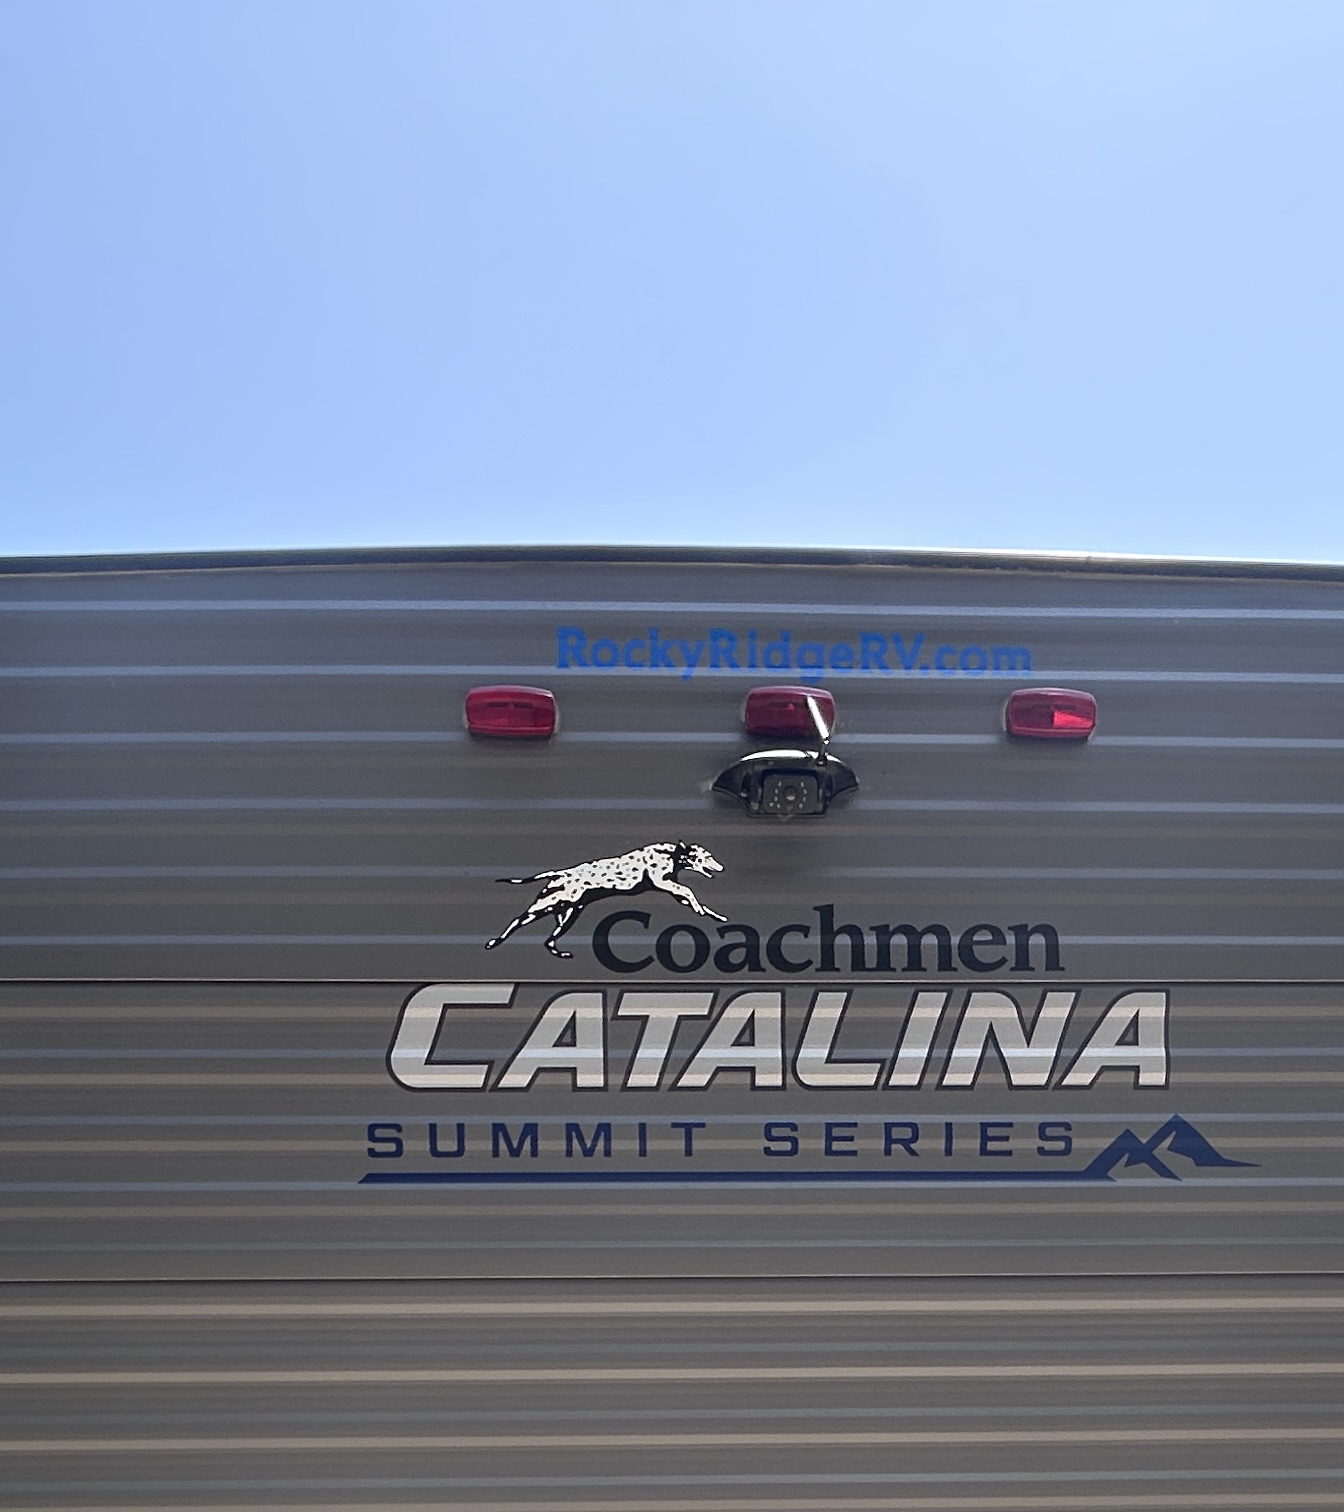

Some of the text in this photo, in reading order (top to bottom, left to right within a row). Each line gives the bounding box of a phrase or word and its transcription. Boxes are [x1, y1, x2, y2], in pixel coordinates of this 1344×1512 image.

[556, 626, 1033, 683] RockyRidgeRV.com
[591, 904, 1065, 973] Coachmen
[385, 981, 1170, 1092] CATALINA
[367, 1121, 1073, 1159] SUMMIT SERIES
